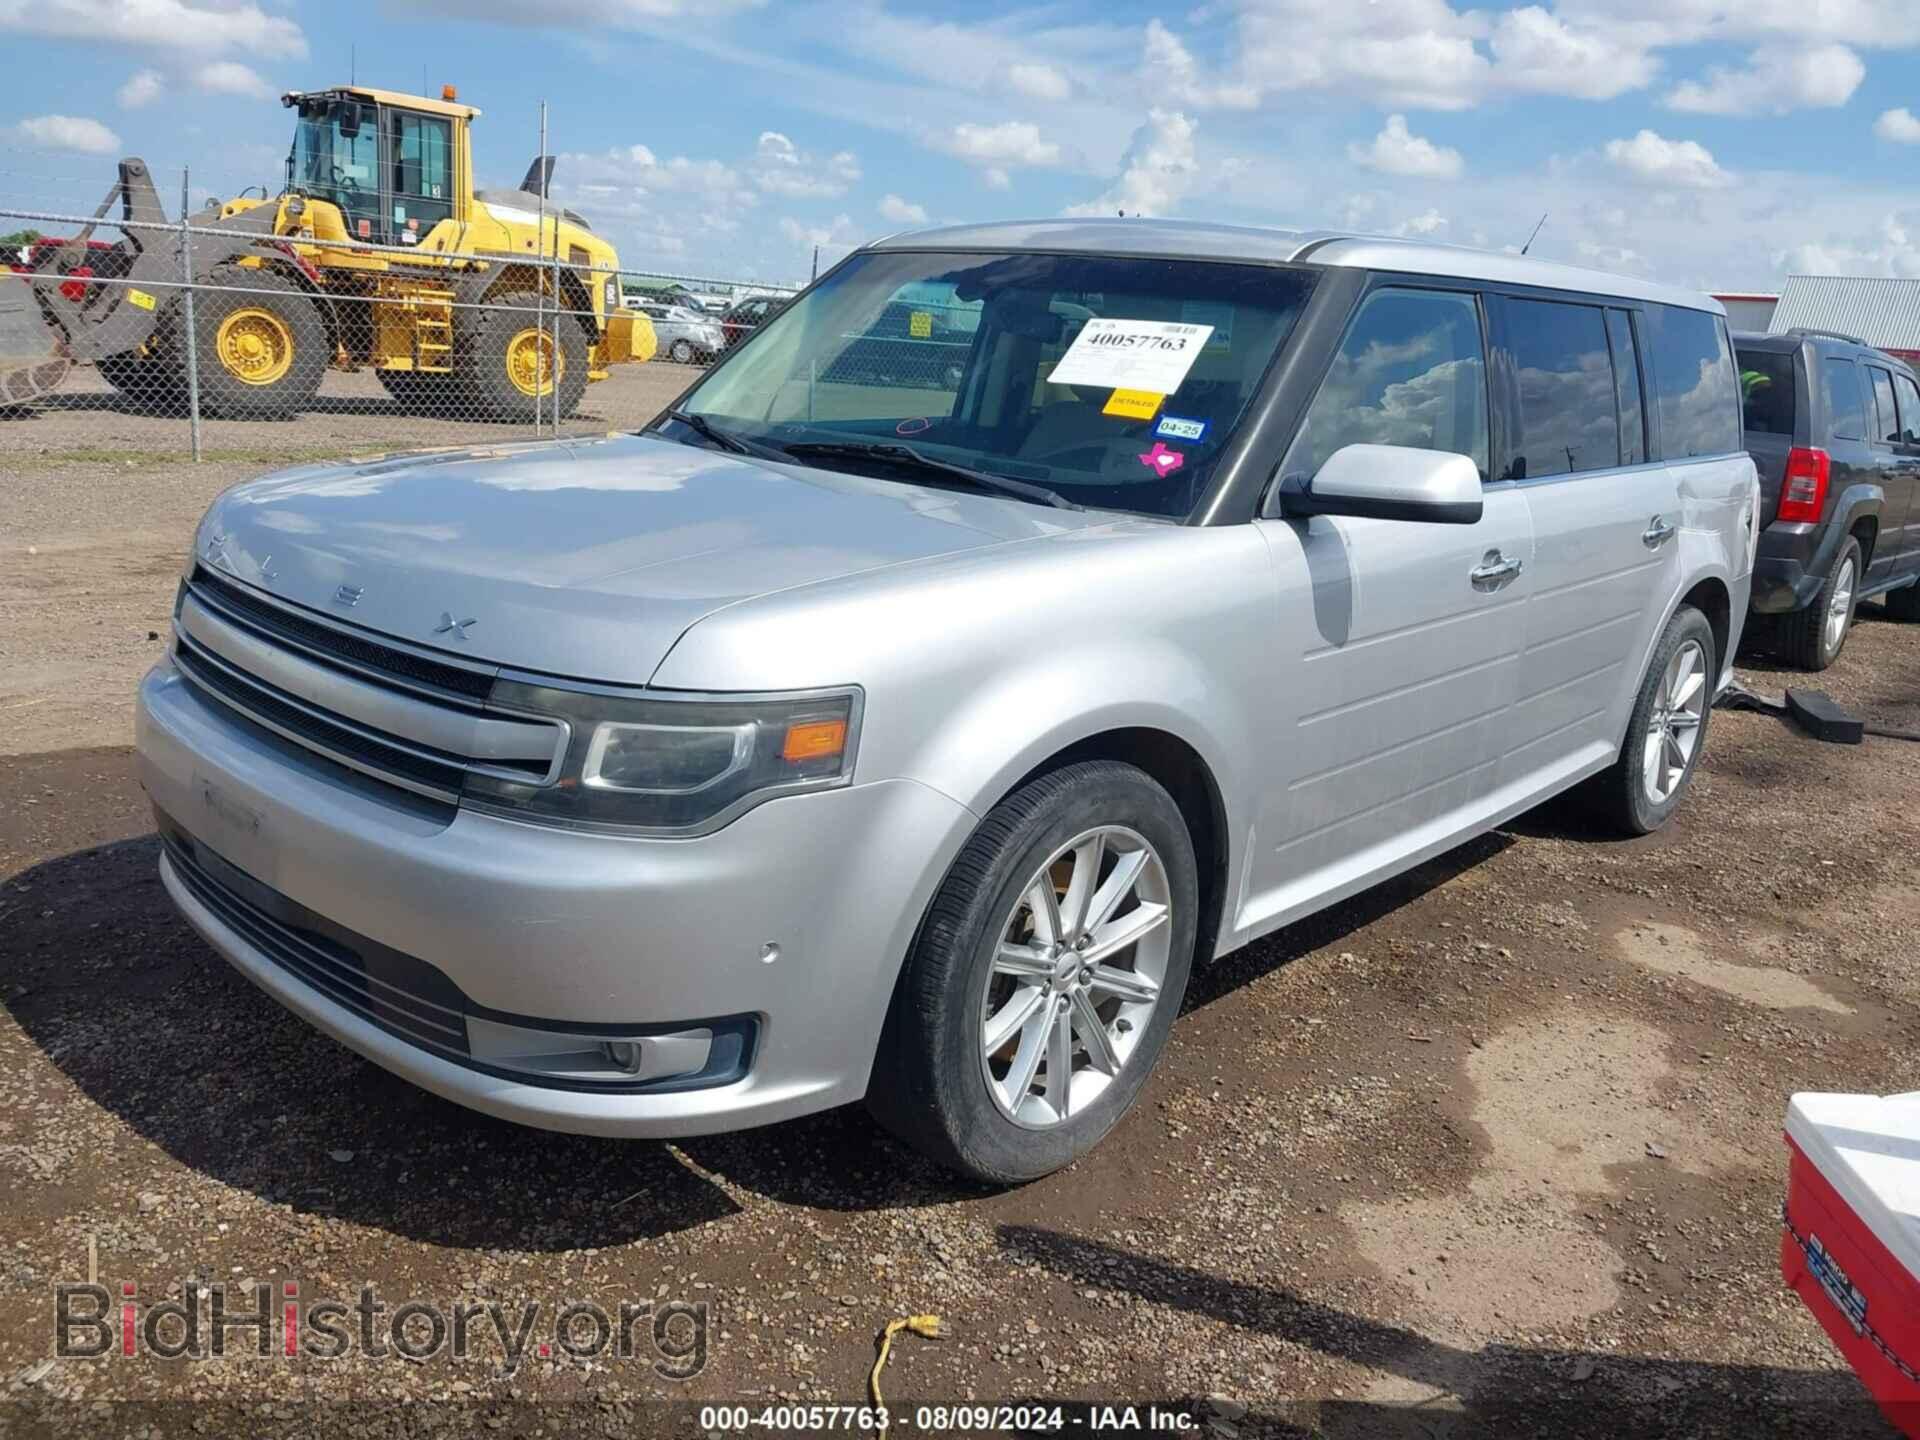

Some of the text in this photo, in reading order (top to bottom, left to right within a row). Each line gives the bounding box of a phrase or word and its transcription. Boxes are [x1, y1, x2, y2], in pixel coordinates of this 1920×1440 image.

[1088, 333, 1187, 351] 40057763
[1113, 397, 1154, 407] DETAILED
[1160, 422, 1199, 435] 04-25
